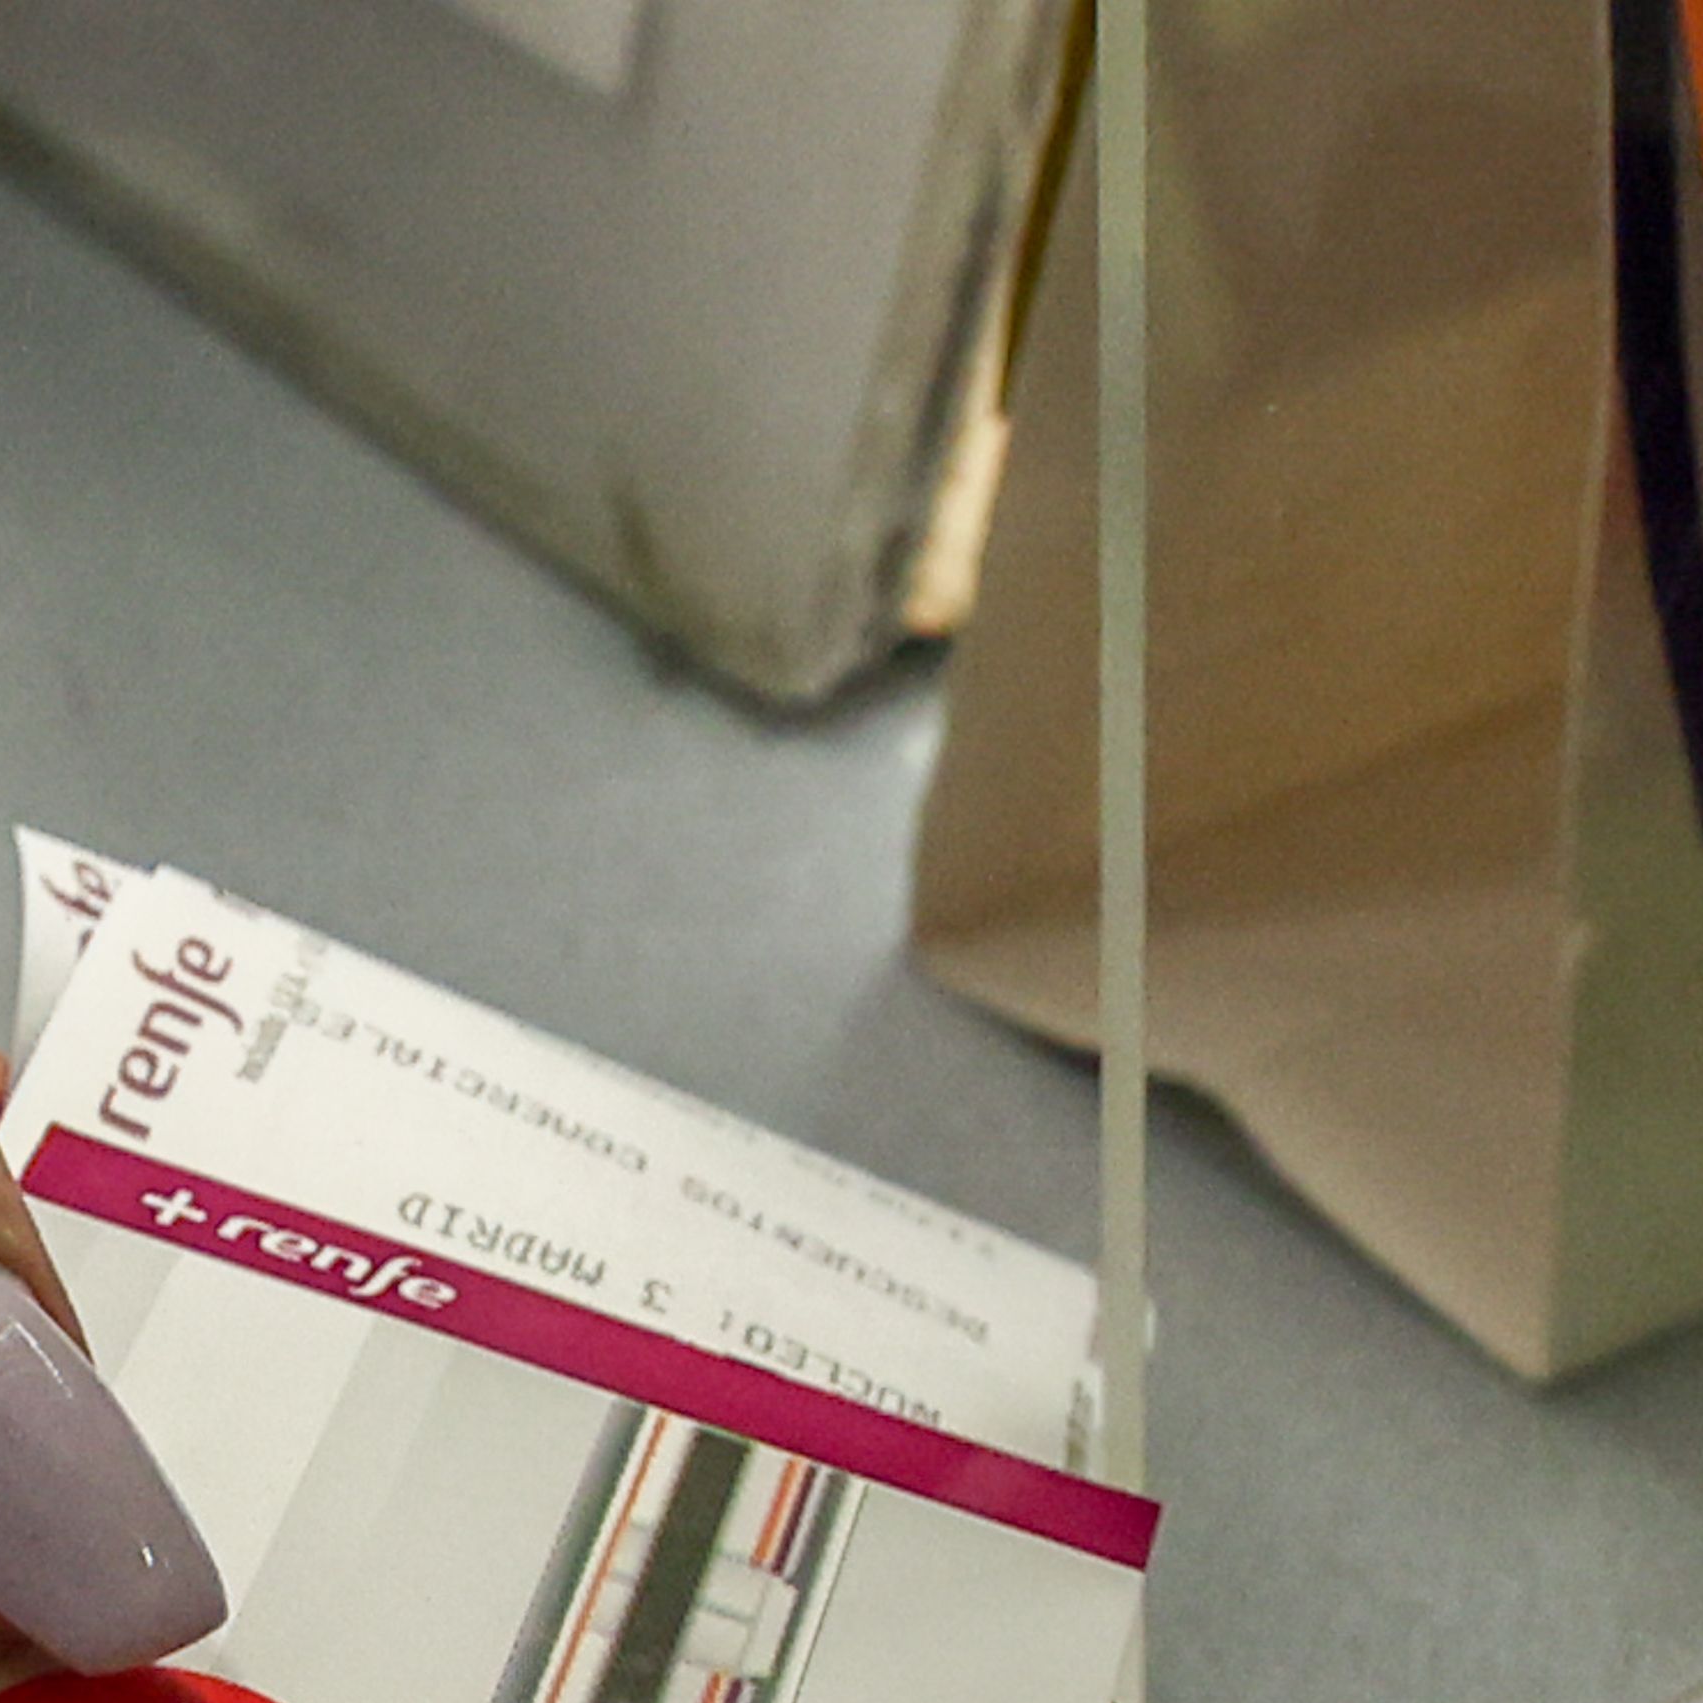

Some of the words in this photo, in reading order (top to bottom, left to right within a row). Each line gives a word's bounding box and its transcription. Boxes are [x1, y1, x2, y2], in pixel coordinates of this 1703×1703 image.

[99, 934, 245, 1141] renfe
[397, 1189, 611, 1288] MADRID
[637, 1279, 676, 1317] 3
